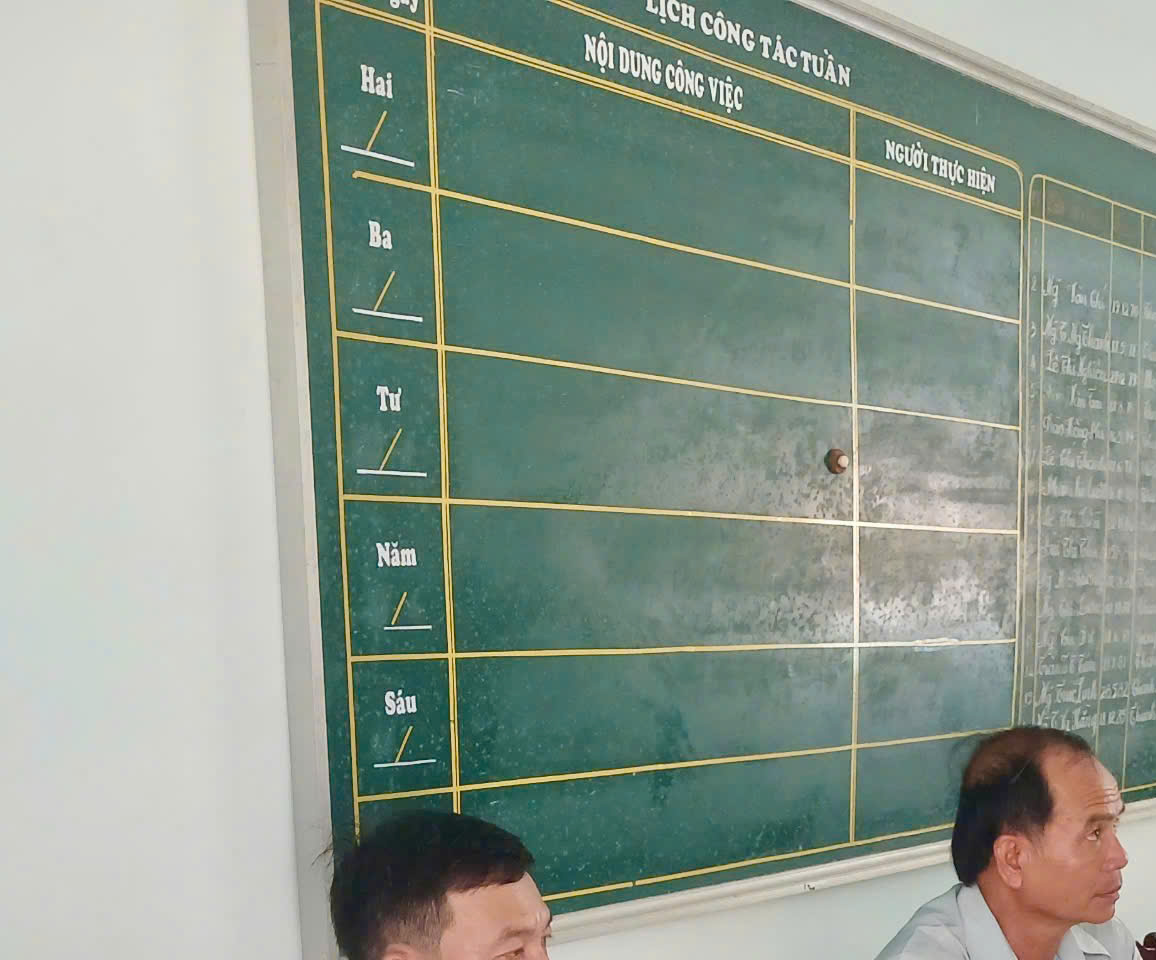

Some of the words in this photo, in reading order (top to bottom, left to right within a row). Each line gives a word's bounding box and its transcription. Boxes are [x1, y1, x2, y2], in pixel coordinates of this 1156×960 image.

[700, 11, 756, 52] CÔNG
[759, 35, 798, 69] TÁC
[799, 49, 851, 88] TUẦN
[360, 64, 393, 99] Hai
[584, 31, 615, 73] NỘI
[618, 46, 662, 84] DUNG
[665, 59, 705, 98] CÔNG
[707, 75, 744, 114] VIỆC
[885, 139, 929, 172] NGƯỜI
[930, 155, 965, 186] THỰC
[967, 166, 996, 195] HIỆN
[368, 219, 393, 250] Ba
[376, 385, 402, 412] Tư
[375, 541, 417, 568] Năm
[384, 688, 418, 716] Sáu
